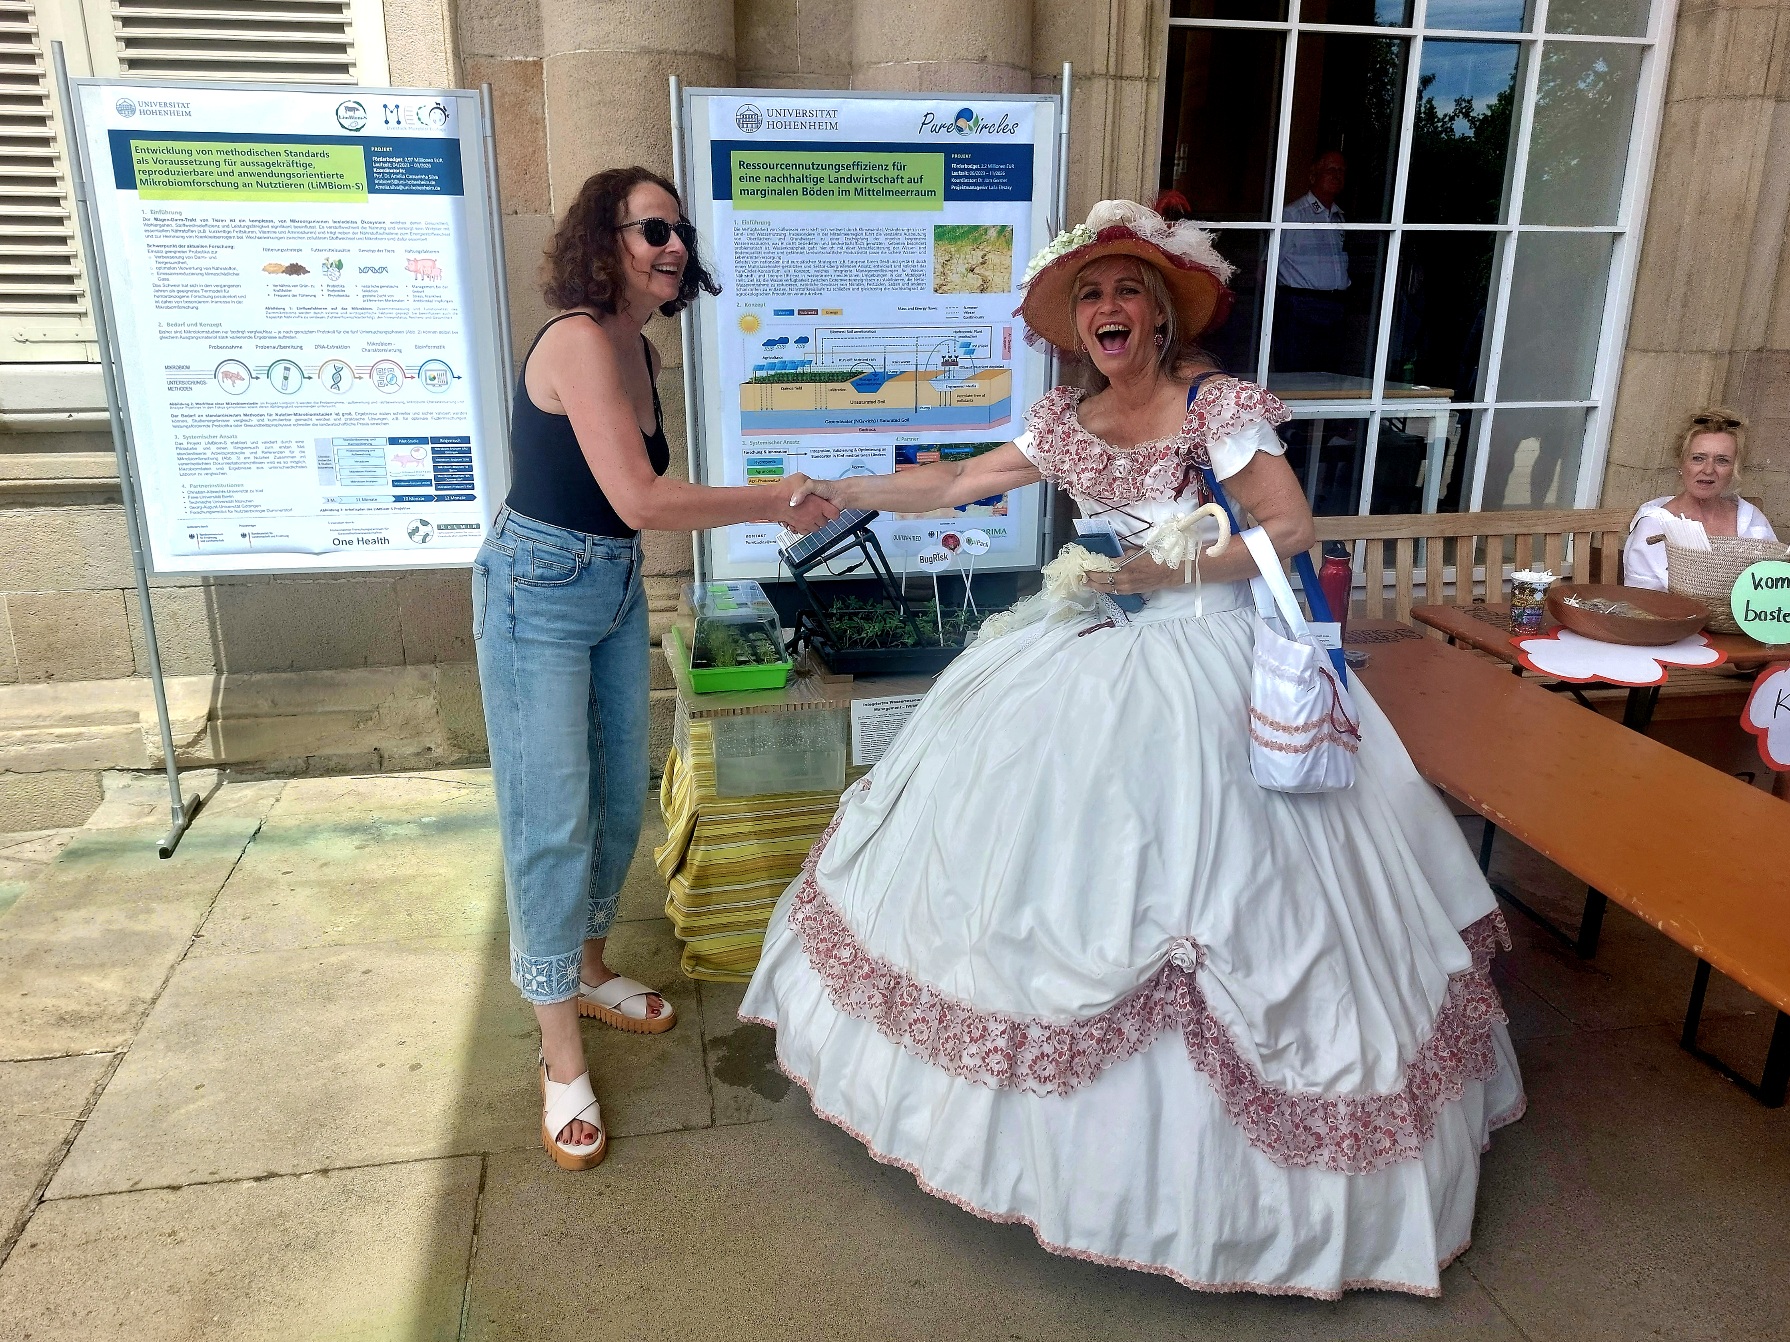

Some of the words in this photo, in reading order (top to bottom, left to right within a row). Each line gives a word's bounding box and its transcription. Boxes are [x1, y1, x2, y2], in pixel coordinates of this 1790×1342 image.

[767, 109, 838, 118] UNIVERSITÄT
[767, 121, 838, 130] HOHENHEIM
[135, 146, 192, 157] Entwicklung
[216, 148, 281, 157] methodischen
[284, 150, 330, 158] Standards
[152, 158, 220, 167] Voraussetzung
[240, 160, 315, 169] aussagekräftige,
[739, 160, 888, 172] Ressourcennutzungseffizienz
[892, 162, 907, 171] für
[138, 169, 214, 180] reproduzierbare
[238, 171, 344, 180] anwendungsorientierte
[764, 174, 824, 185] nachhaltige
[828, 175, 908, 184] Landwirtschaft
[912, 175, 923, 184] auf
[140, 179, 239, 189] Mikrobiomforschung
[308, 182, 364, 191] (LiMBiom-S)
[740, 187, 798, 198] marginalen
[802, 187, 834, 196] Böden
[838, 187, 850, 196] im
[854, 187, 936, 196] Mittelmeerraum
[332, 538, 353, 546] One
[357, 537, 390, 545] Health
[920, 553, 948, 564] BugRisk
